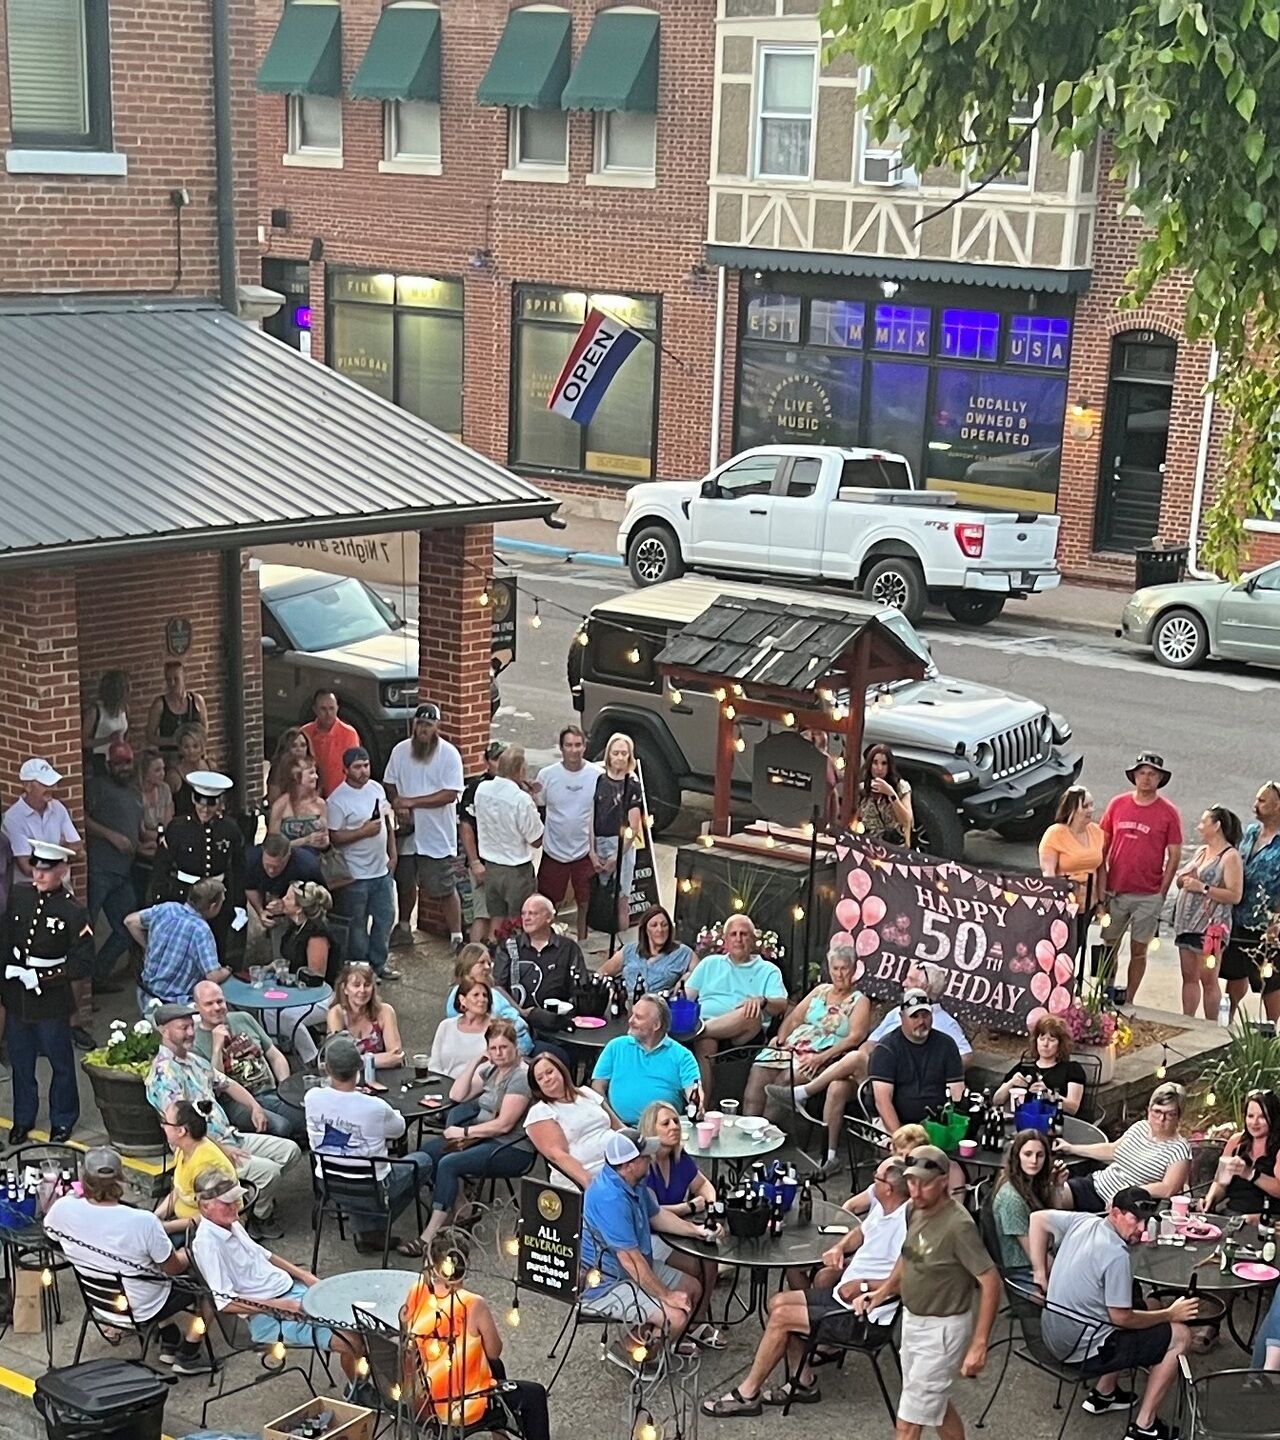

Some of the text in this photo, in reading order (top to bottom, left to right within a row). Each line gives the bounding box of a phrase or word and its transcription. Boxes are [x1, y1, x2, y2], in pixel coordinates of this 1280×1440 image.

[750, 315, 796, 334] EST
[1010, 339, 1063, 360] USA
[563, 329, 615, 402] OPEN
[784, 399, 814, 414] LIVE
[969, 396, 1028, 414] LOCALLY
[777, 414, 820, 430] MUSIC
[965, 412, 1014, 429] OWNED
[960, 427, 1030, 447] OPERATED
[914, 884, 1008, 928] HAPPY
[874, 951, 1026, 1014] BIHDAY
[537, 1225, 561, 1243] ALL
[524, 1234, 574, 1259] BEVERAGES
[530, 1251, 566, 1268] must be
[526, 1261, 569, 1280] purchased
[532, 1273, 544, 1284] on
